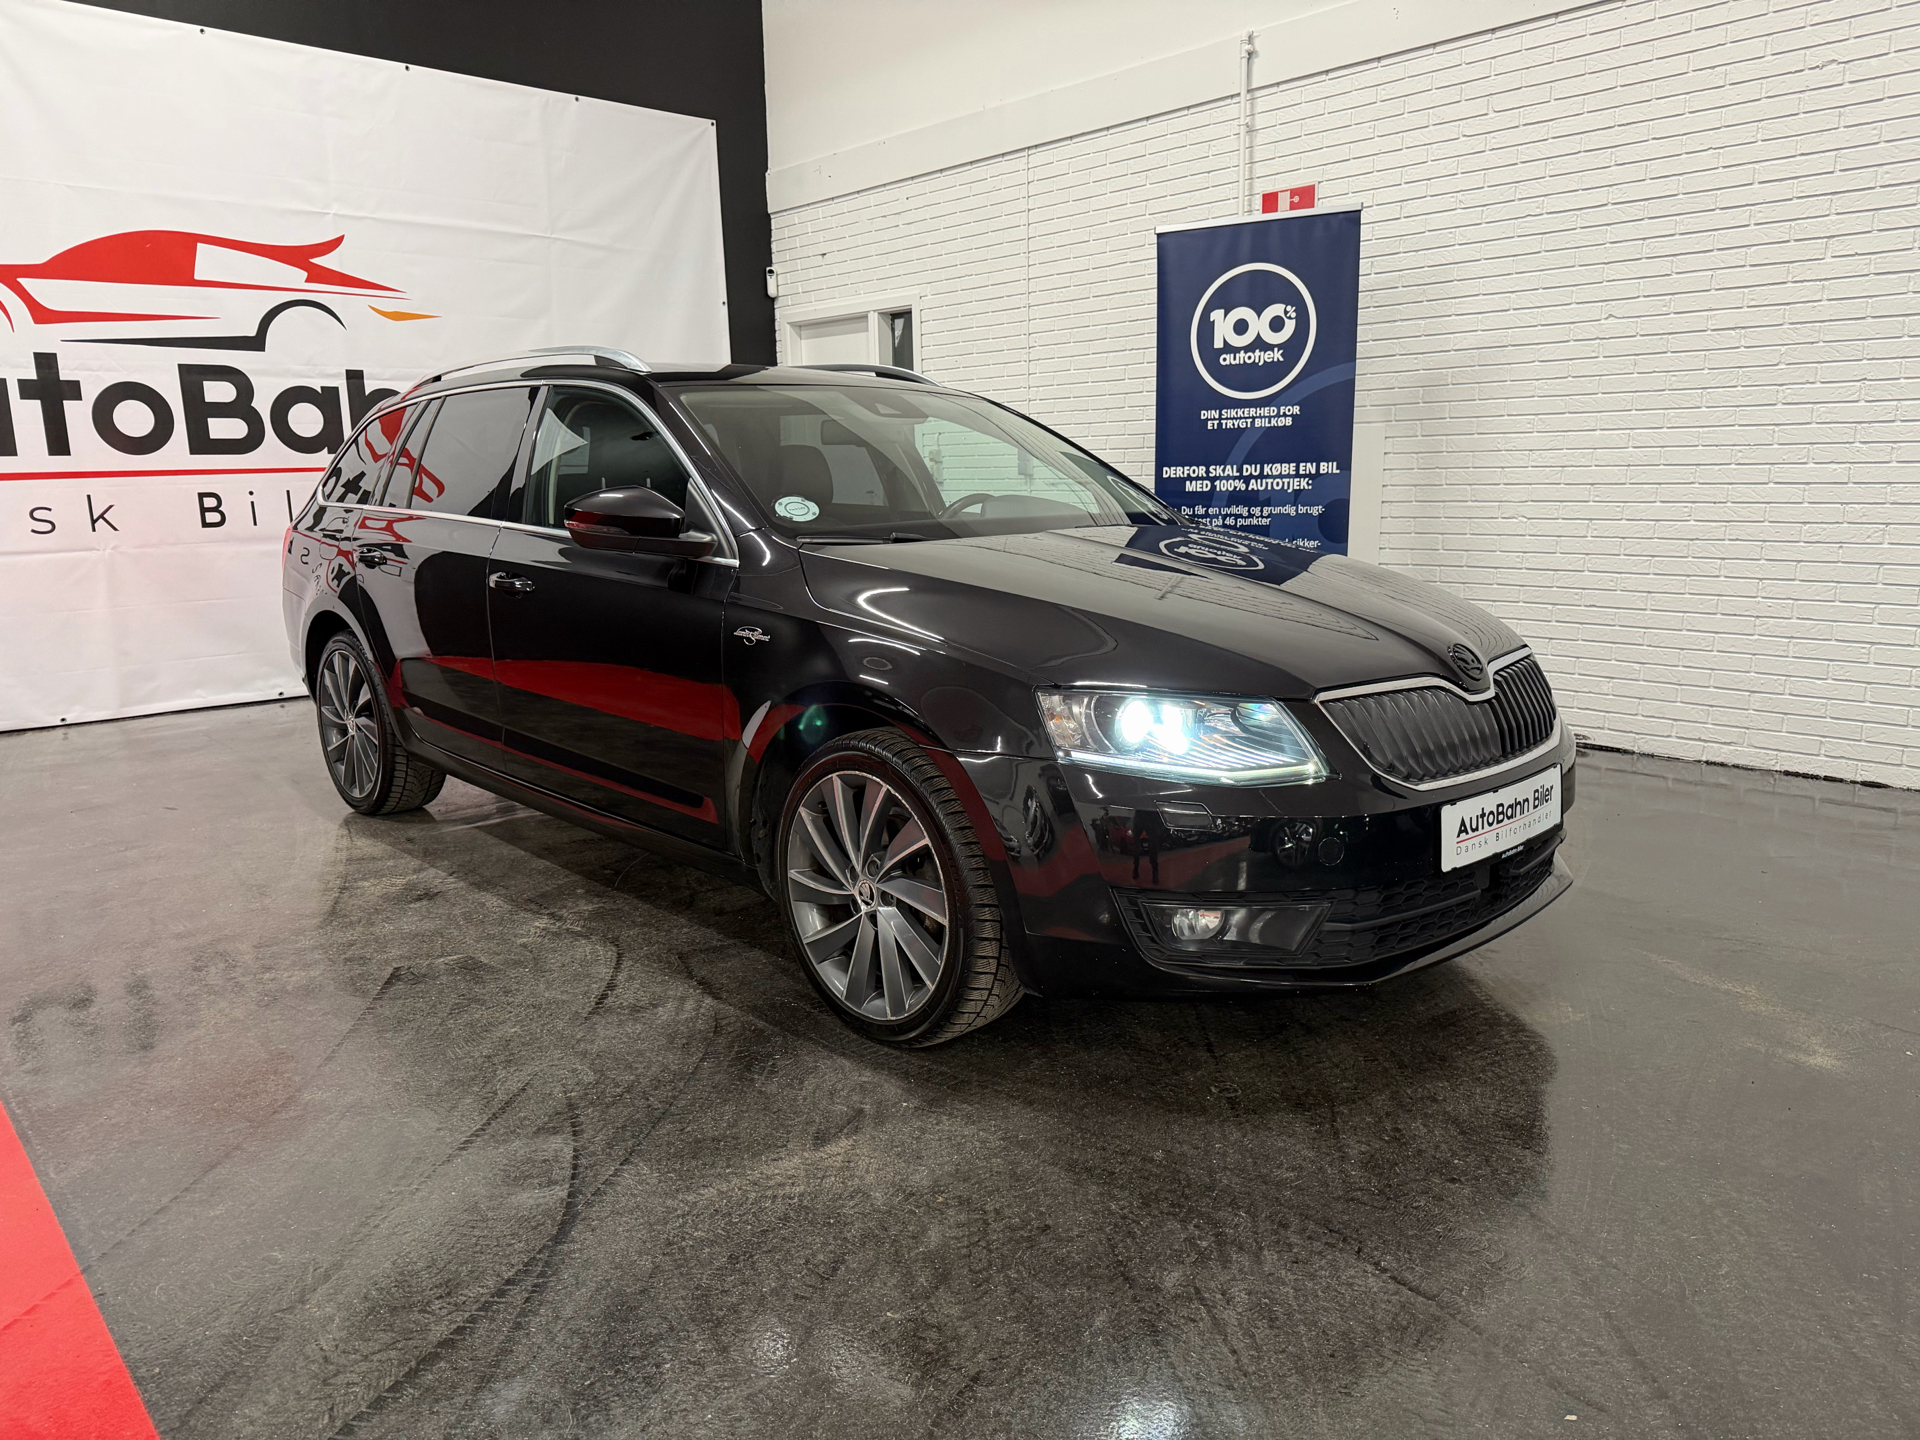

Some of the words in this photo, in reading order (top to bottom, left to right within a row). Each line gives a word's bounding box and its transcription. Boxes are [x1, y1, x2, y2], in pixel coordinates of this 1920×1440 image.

[1219, 347, 1284, 366] autotjek
[1200, 409, 1220, 420] DIN
[1221, 406, 1278, 419] SIKKERHED
[1279, 405, 1301, 416] FOR
[1207, 420, 1220, 430] ET
[1220, 418, 1253, 429] TRYGT
[1254, 416, 1293, 428] BILKØB
[1162, 465, 1207, 479] DERFOR
[1209, 464, 1240, 478] SKAL
[1242, 463, 1261, 477] DU
[1263, 462, 1296, 476] KØBE
[1299, 462, 1317, 475] EN
[1319, 461, 1341, 474] BIL
[1185, 479, 1211, 493] MED
[1213, 478, 1246, 492] 100%
[1247, 477, 1313, 493] AUTOTJEK:
[1181, 505, 1194, 516] Du
[1194, 504, 1208, 516] får
[1208, 507, 1219, 516] en
[1220, 504, 1249, 517] uvildig
[1249, 507, 1261, 517] og
[1262, 504, 1297, 517] grundig
[1298, 504, 1326, 517] brugt-
[1212, 515, 1223, 528] på
[1223, 516, 1236, 526] 46
[1236, 516, 1272, 529] punkter
[1456, 797, 1530, 839] AutoBahn
[1532, 783, 1554, 810] Biler
[1455, 837, 1489, 856] Dansk
[1495, 810, 1552, 842] Bilforhandler
